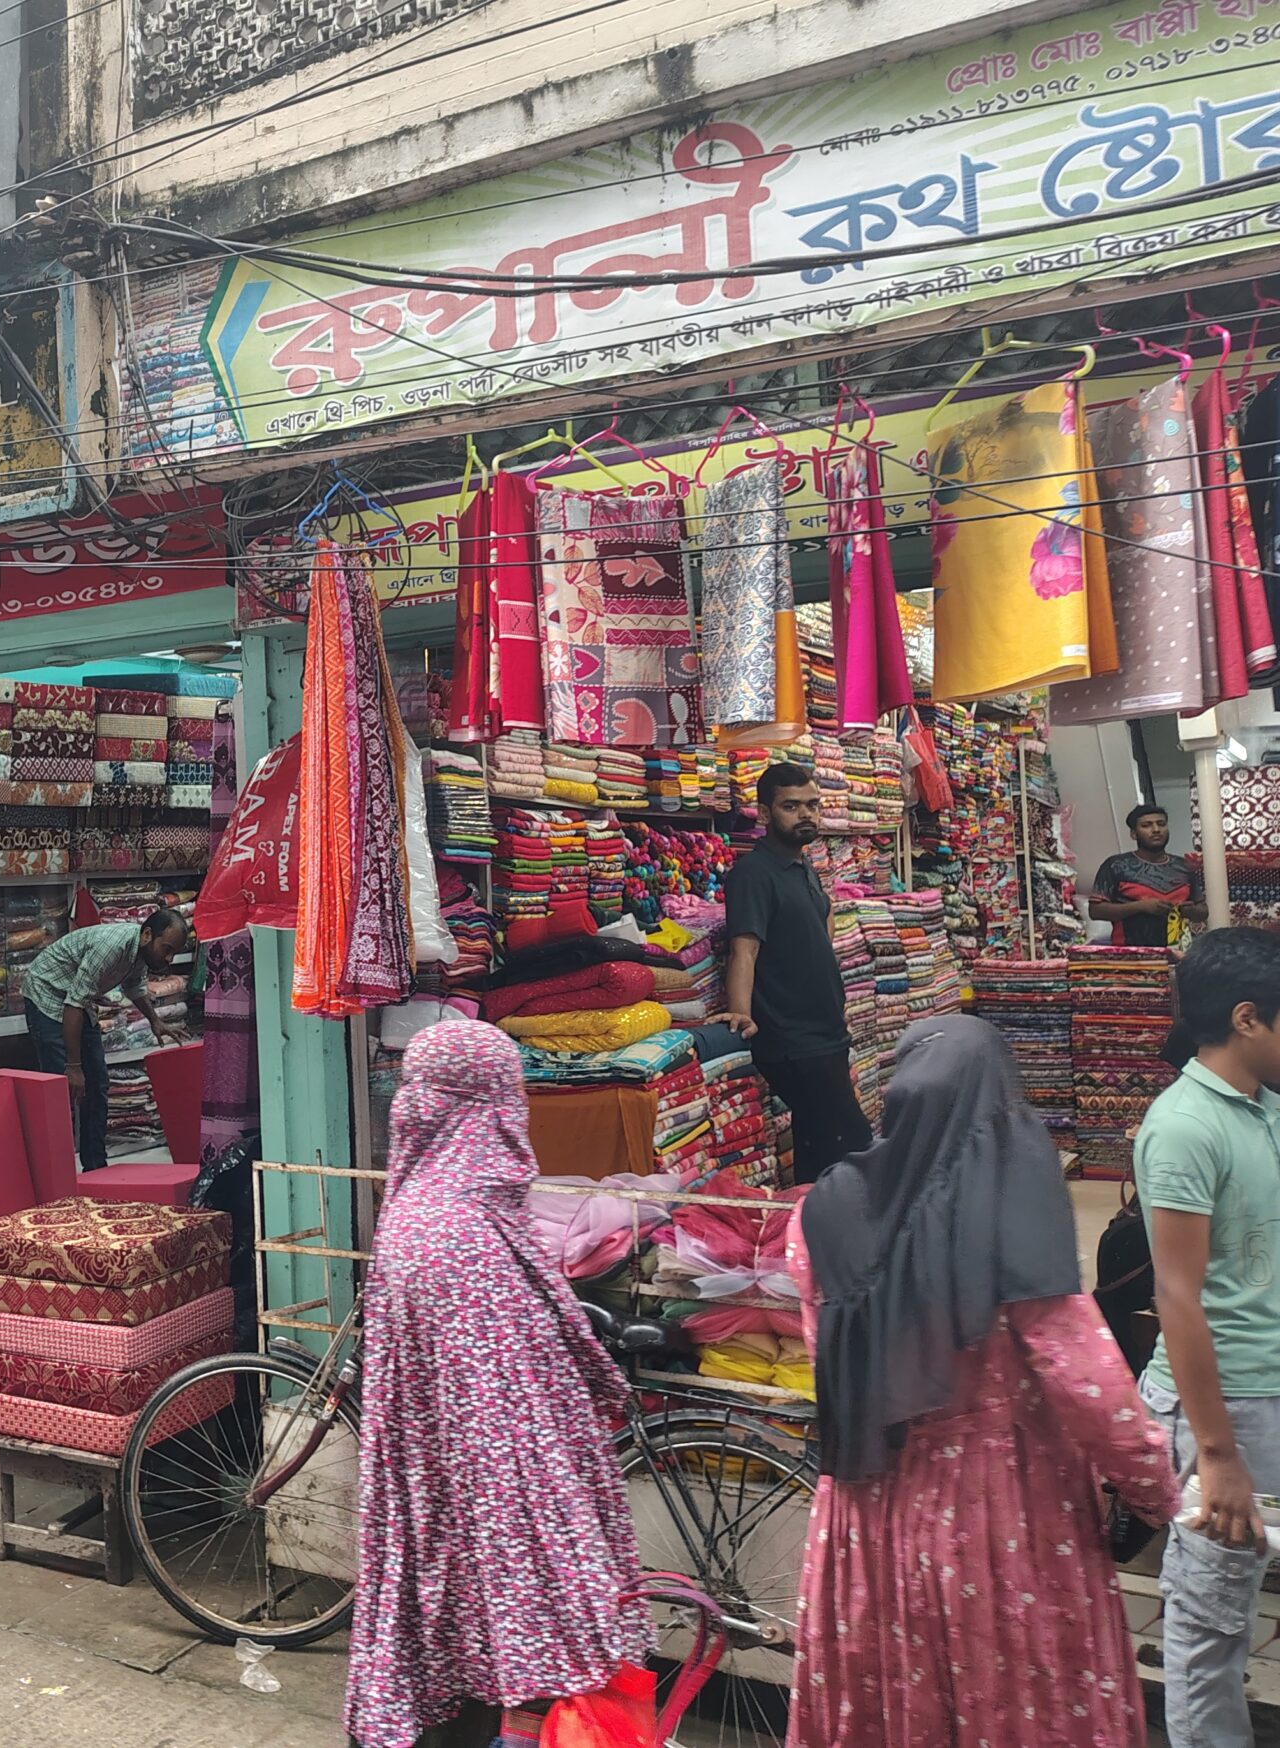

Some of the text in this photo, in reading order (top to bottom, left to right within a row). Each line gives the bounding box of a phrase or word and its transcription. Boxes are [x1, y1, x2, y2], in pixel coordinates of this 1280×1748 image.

[946, 52, 1017, 93] প্রোঃ
[1030, 31, 1101, 70] মোঃ
[266, 411, 319, 435] এখানে
[400, 379, 451, 408] ওড়না
[597, 346, 630, 366] সহ
[278, 792, 299, 892] APEX FOAM
